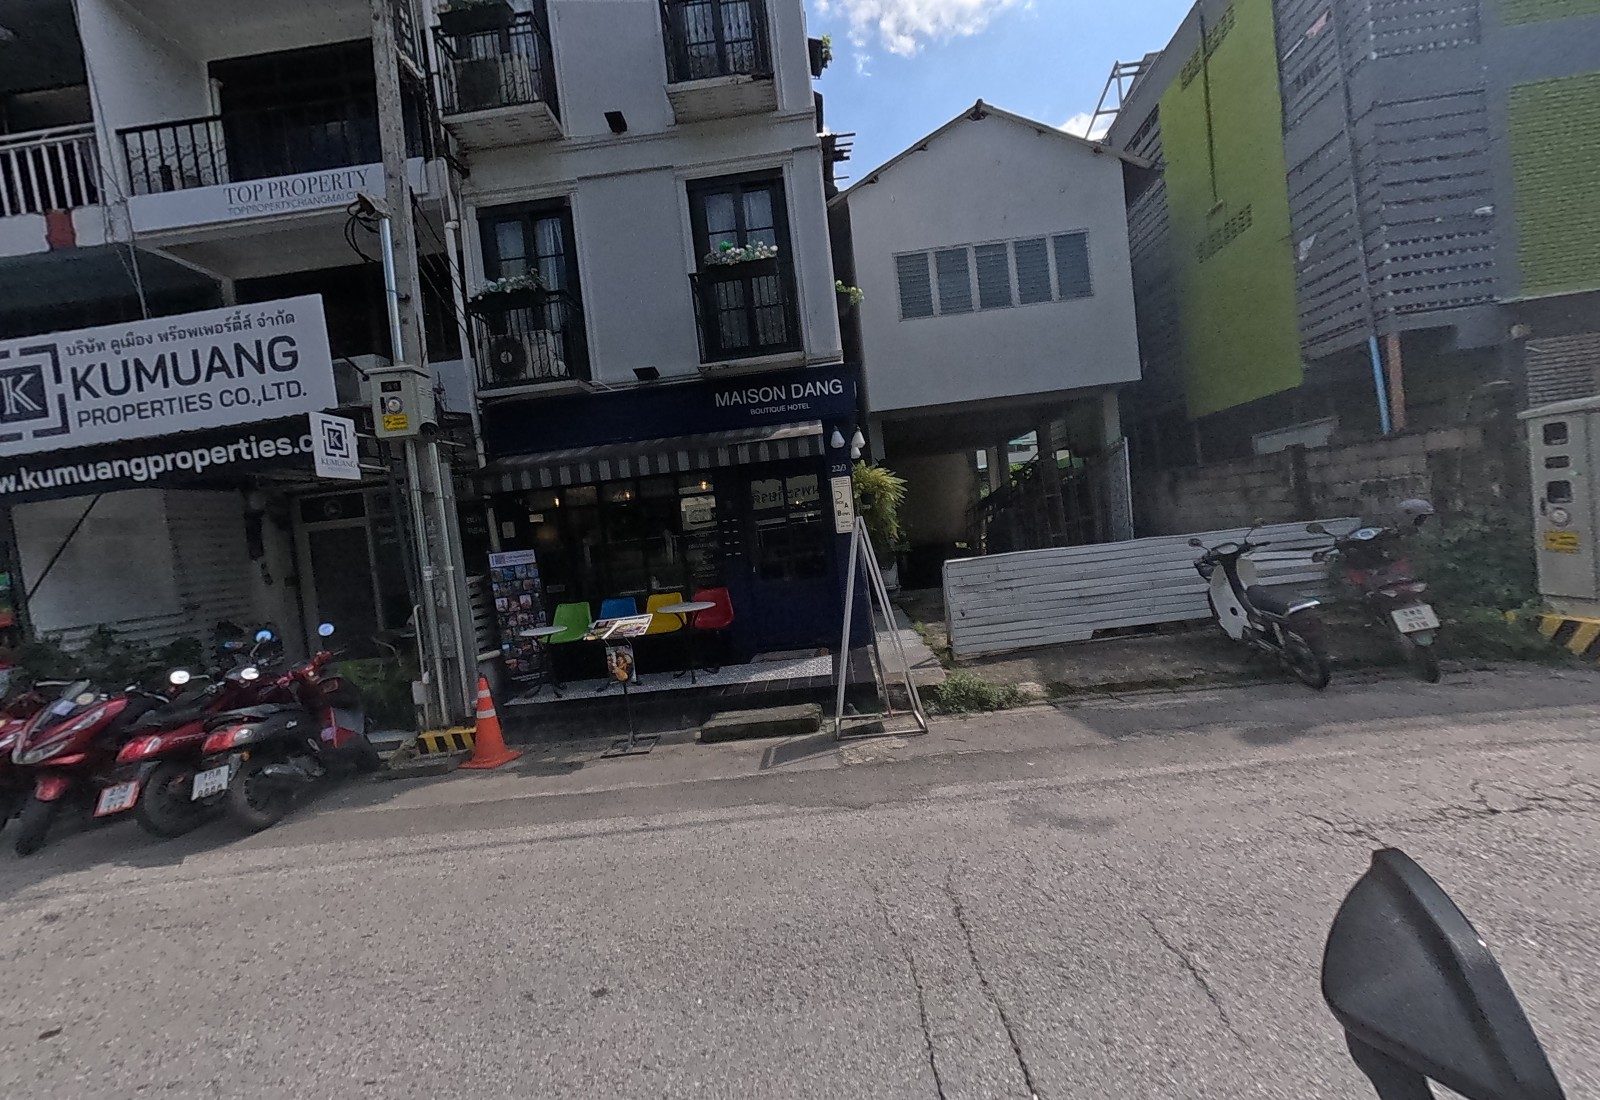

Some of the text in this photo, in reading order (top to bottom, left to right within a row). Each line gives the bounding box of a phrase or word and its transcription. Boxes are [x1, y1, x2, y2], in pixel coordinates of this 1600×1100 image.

[223, 168, 369, 205] TOP PROPERTY
[66, 337, 106, 356] บริษัท
[110, 331, 153, 355] คูเมือง
[257, 309, 296, 328] จำกัด
[70, 334, 300, 402] KUMUANG
[77, 379, 308, 428] PROPERTIES CO.,LTD.
[714, 378, 844, 408] MAISON DANG
[750, 402, 811, 416] BOUTIQUE HOTEL
[320, 456, 356, 469] KUMUANG
[831, 463, 847, 473] 22/3
